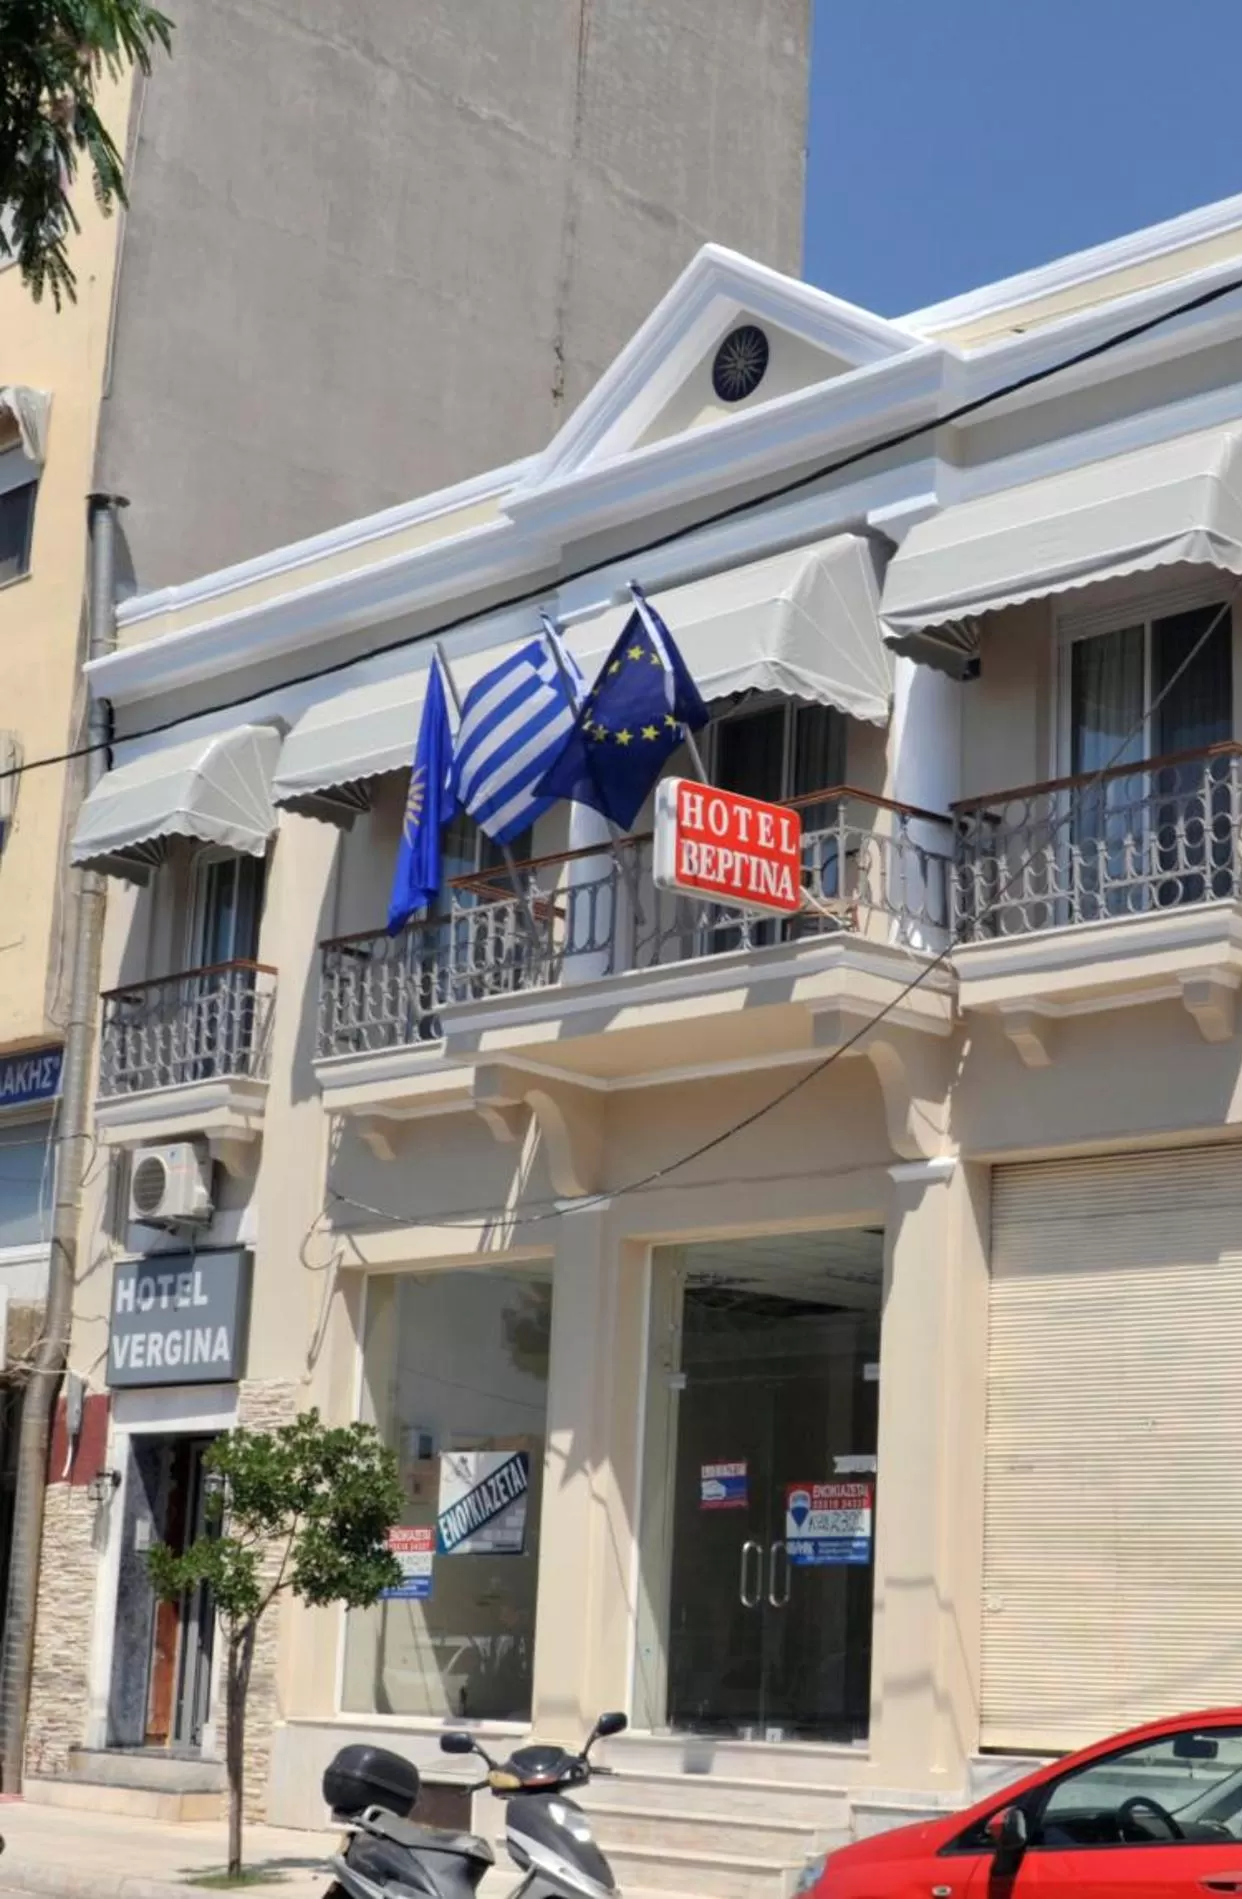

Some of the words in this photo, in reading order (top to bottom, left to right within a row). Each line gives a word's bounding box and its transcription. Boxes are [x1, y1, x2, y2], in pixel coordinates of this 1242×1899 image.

[680, 790, 796, 855] HOTEL
[680, 839, 796, 902] ΒΕΡΓΙΝΑ
[115, 1271, 208, 1313] HOTEL
[112, 1326, 231, 1370] VERGINA
[438, 1456, 528, 1550] ΕΝΟΙΚΙΑΖΕΤΑΙ
